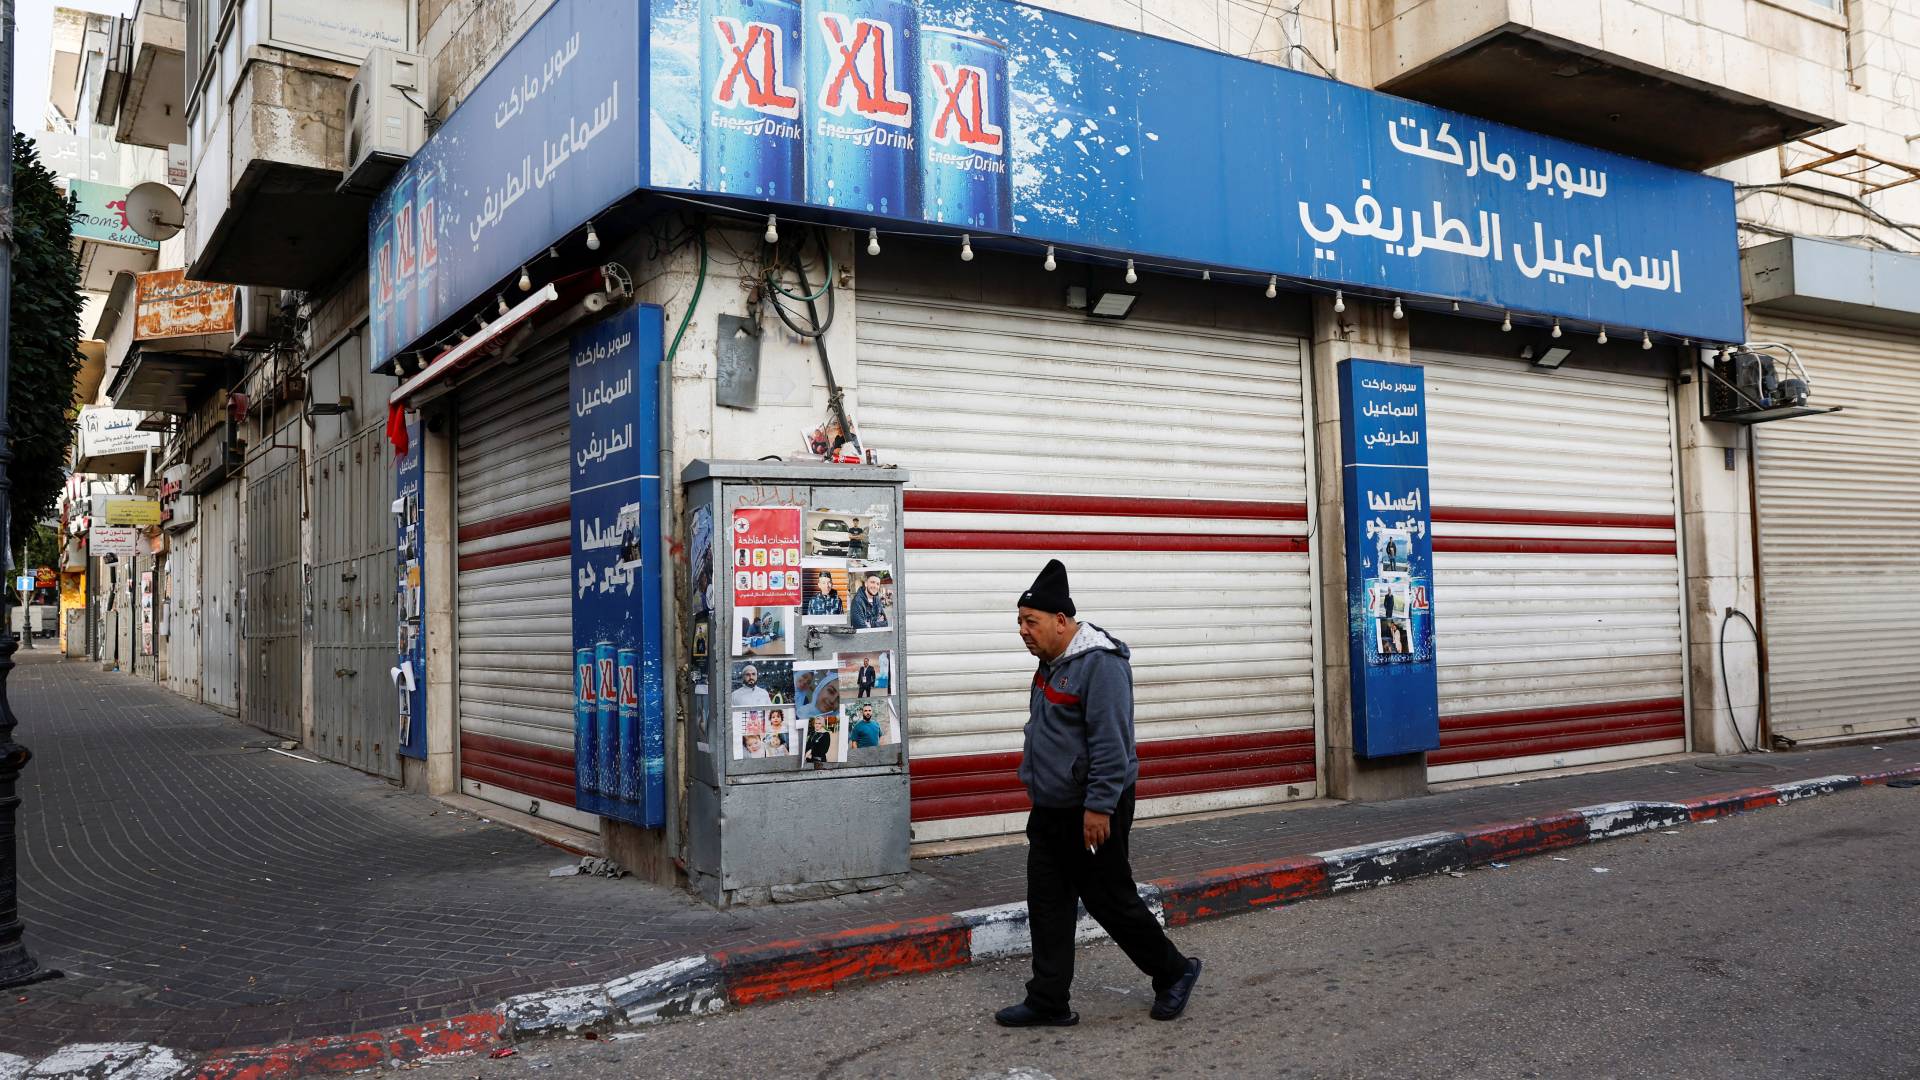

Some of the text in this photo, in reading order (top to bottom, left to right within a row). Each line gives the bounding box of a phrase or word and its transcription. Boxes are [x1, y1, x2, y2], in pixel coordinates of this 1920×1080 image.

[495, 31, 580, 130] سوبر ماركت
[712, 17, 799, 119] XL
[817, 12, 911, 128] XL
[711, 110, 801, 140] Energy Drink
[927, 59, 1003, 155] XL
[817, 117, 914, 151] Energy Drink
[469, 79, 618, 252] اسماعيل الطريفي
[927, 147, 1005, 175] Energy Drink
[1388, 116, 1608, 199] سوبر ماركت
[395, 198, 416, 281] XL
[418, 193, 437, 270] XL
[1299, 178, 1682, 294] اسماعيل الطريفي
[377, 240, 393, 308] XL
[575, 331, 631, 368] سوبر ماركت
[576, 369, 632, 417] اسماعيل
[1361, 378, 1417, 393] سوبر ماركت
[1362, 400, 1418, 418] اسماعيل
[576, 423, 633, 475] الطريفي
[1364, 428, 1419, 449] الطريفي
[580, 505, 628, 550] كسلها
[578, 561, 596, 600] جو
[1412, 586, 1429, 609] XL
[580, 664, 596, 704] XL
[598, 659, 617, 702] XL
[619, 666, 637, 708] XL
